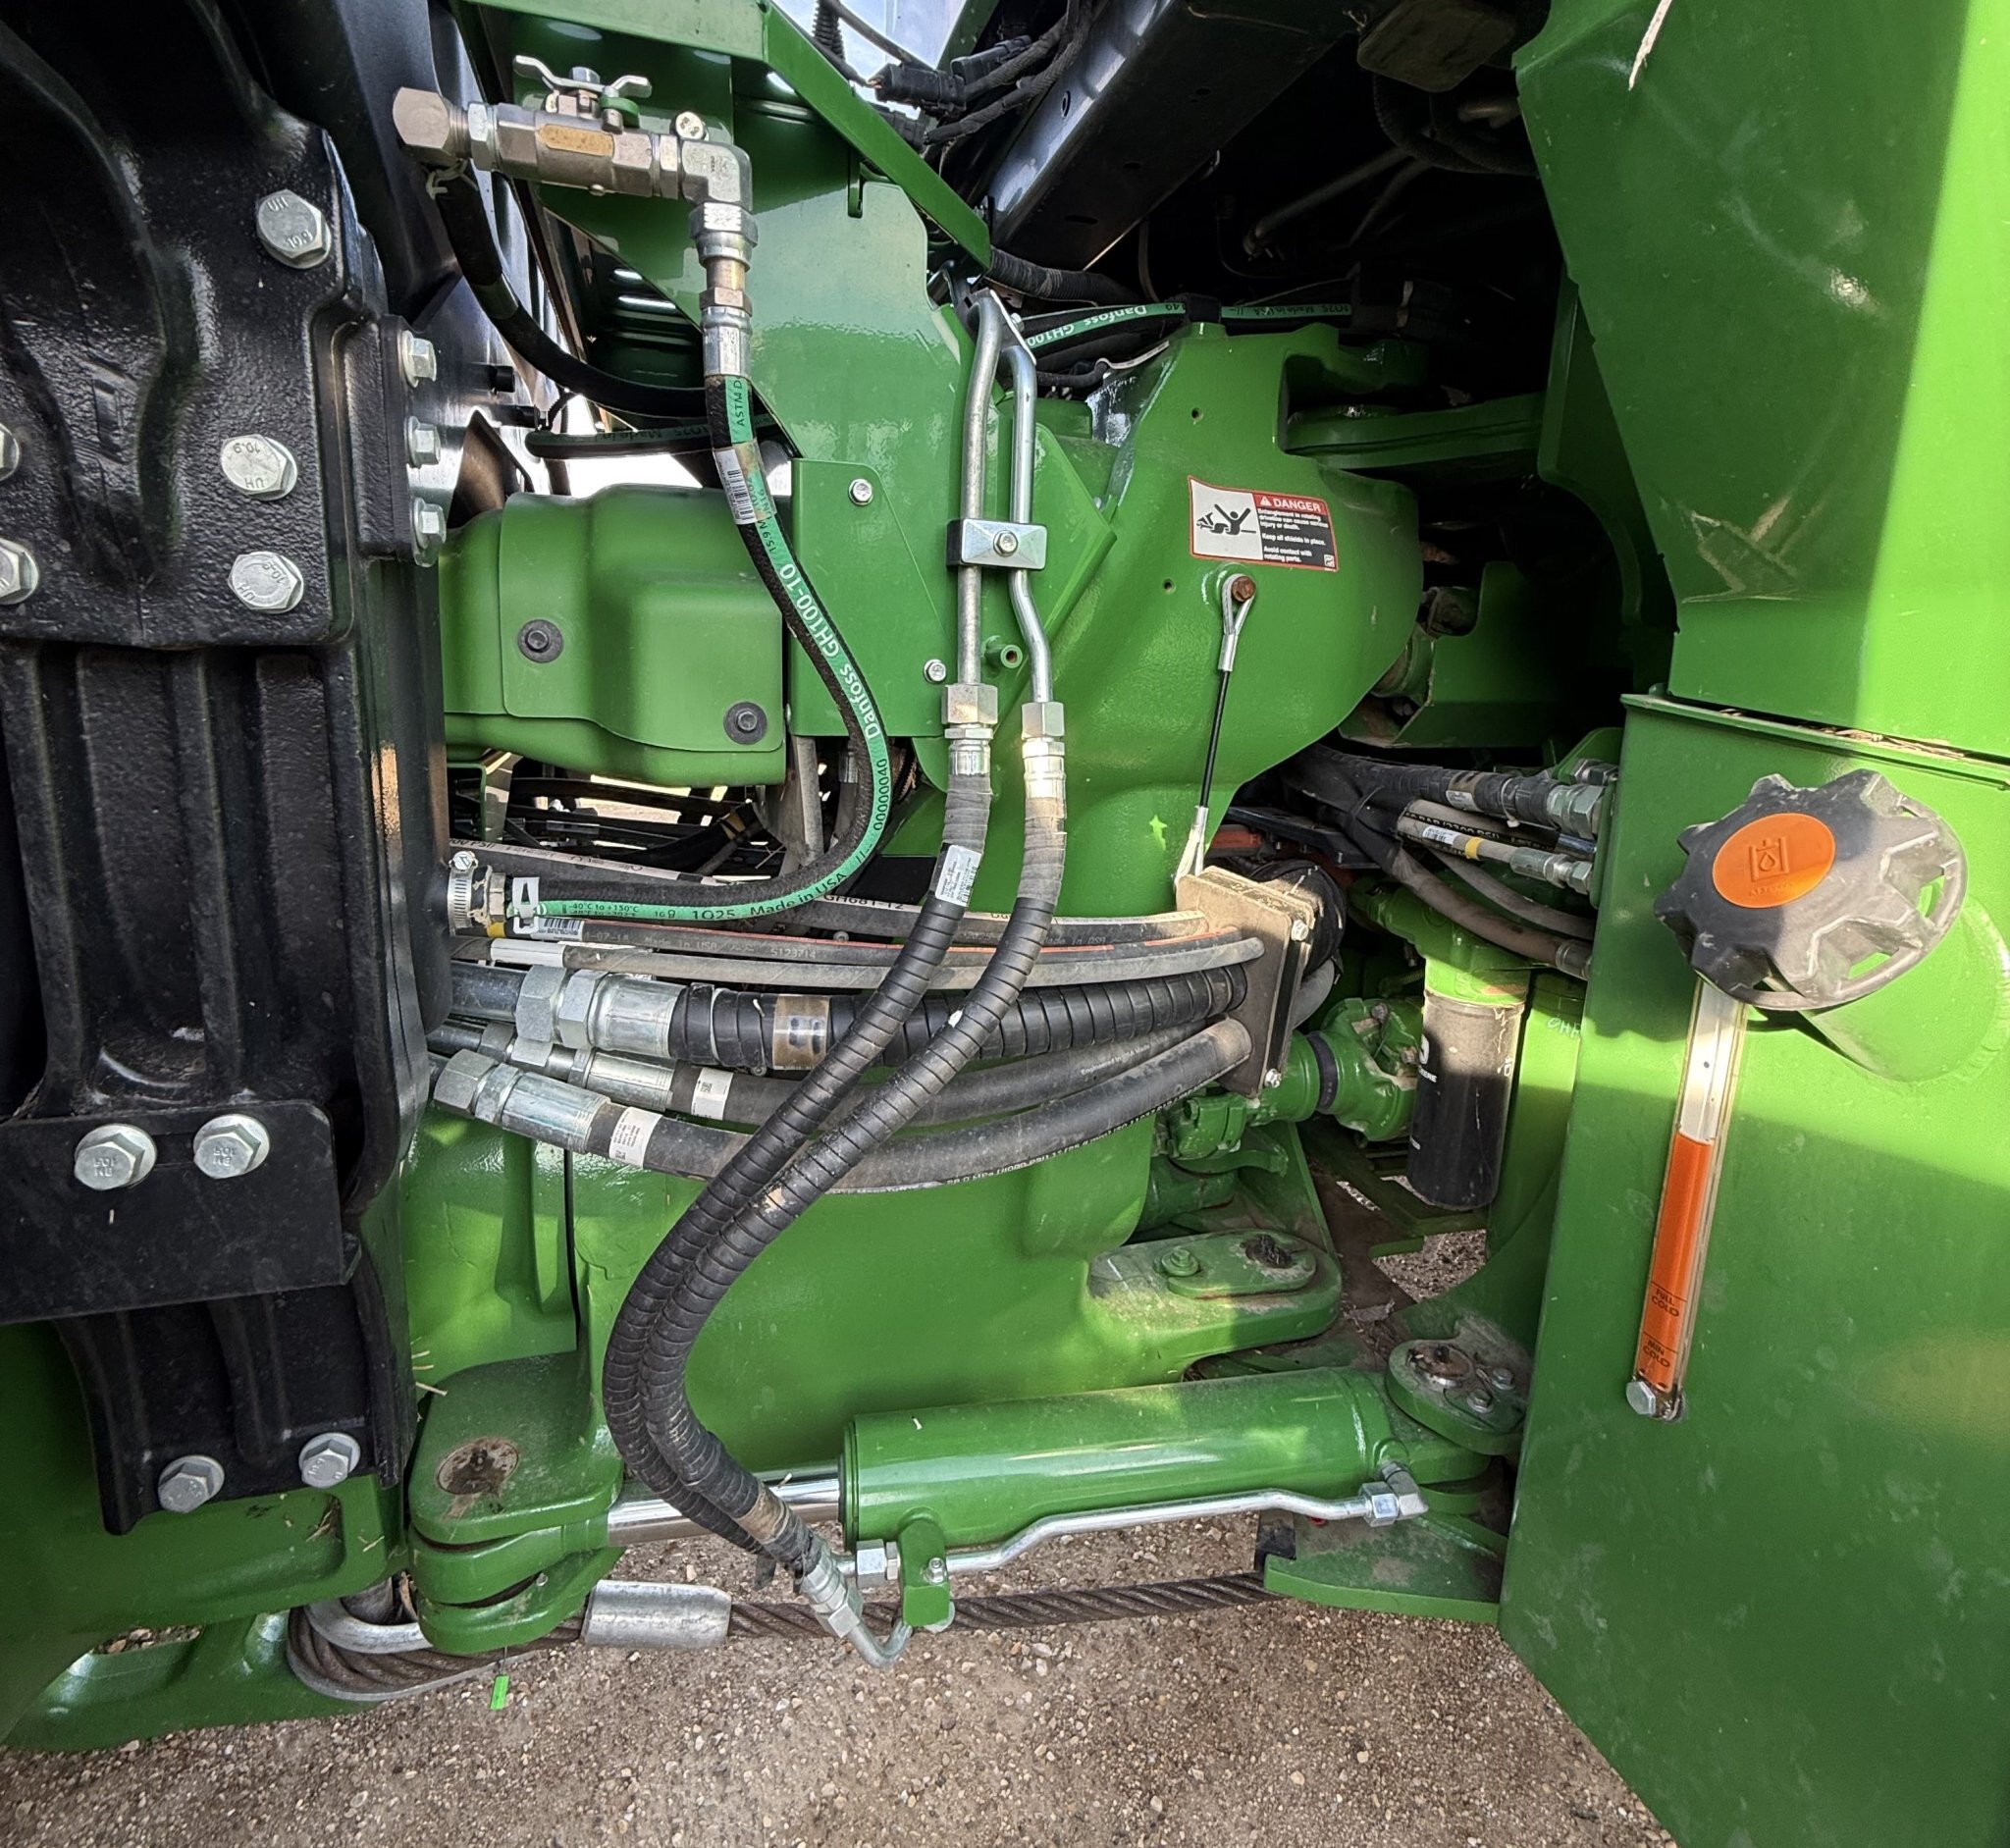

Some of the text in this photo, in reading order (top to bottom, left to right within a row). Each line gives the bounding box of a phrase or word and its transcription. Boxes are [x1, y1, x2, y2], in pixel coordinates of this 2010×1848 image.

[1083, 305, 1146, 326] Danfoss
[734, 394, 745, 426] ASTM
[233, 442, 260, 454] 10.9
[244, 477, 265, 489] UH
[1273, 498, 1321, 512] DANGER
[763, 531, 777, 553] 15.9
[779, 563, 840, 658] GH100-10
[840, 662, 880, 739] Danfoss
[873, 759, 888, 831] 00000040
[692, 909, 736, 921] 1Q25
[750, 898, 795, 916] Made
[798, 891, 814, 904] in
[815, 871, 847, 894] USA
[1651, 1295, 1680, 1317] COLD
[1656, 1288, 1675, 1306] FULL
[1642, 1346, 1671, 1368] COLD
[1647, 1340, 1666, 1356] MIN
